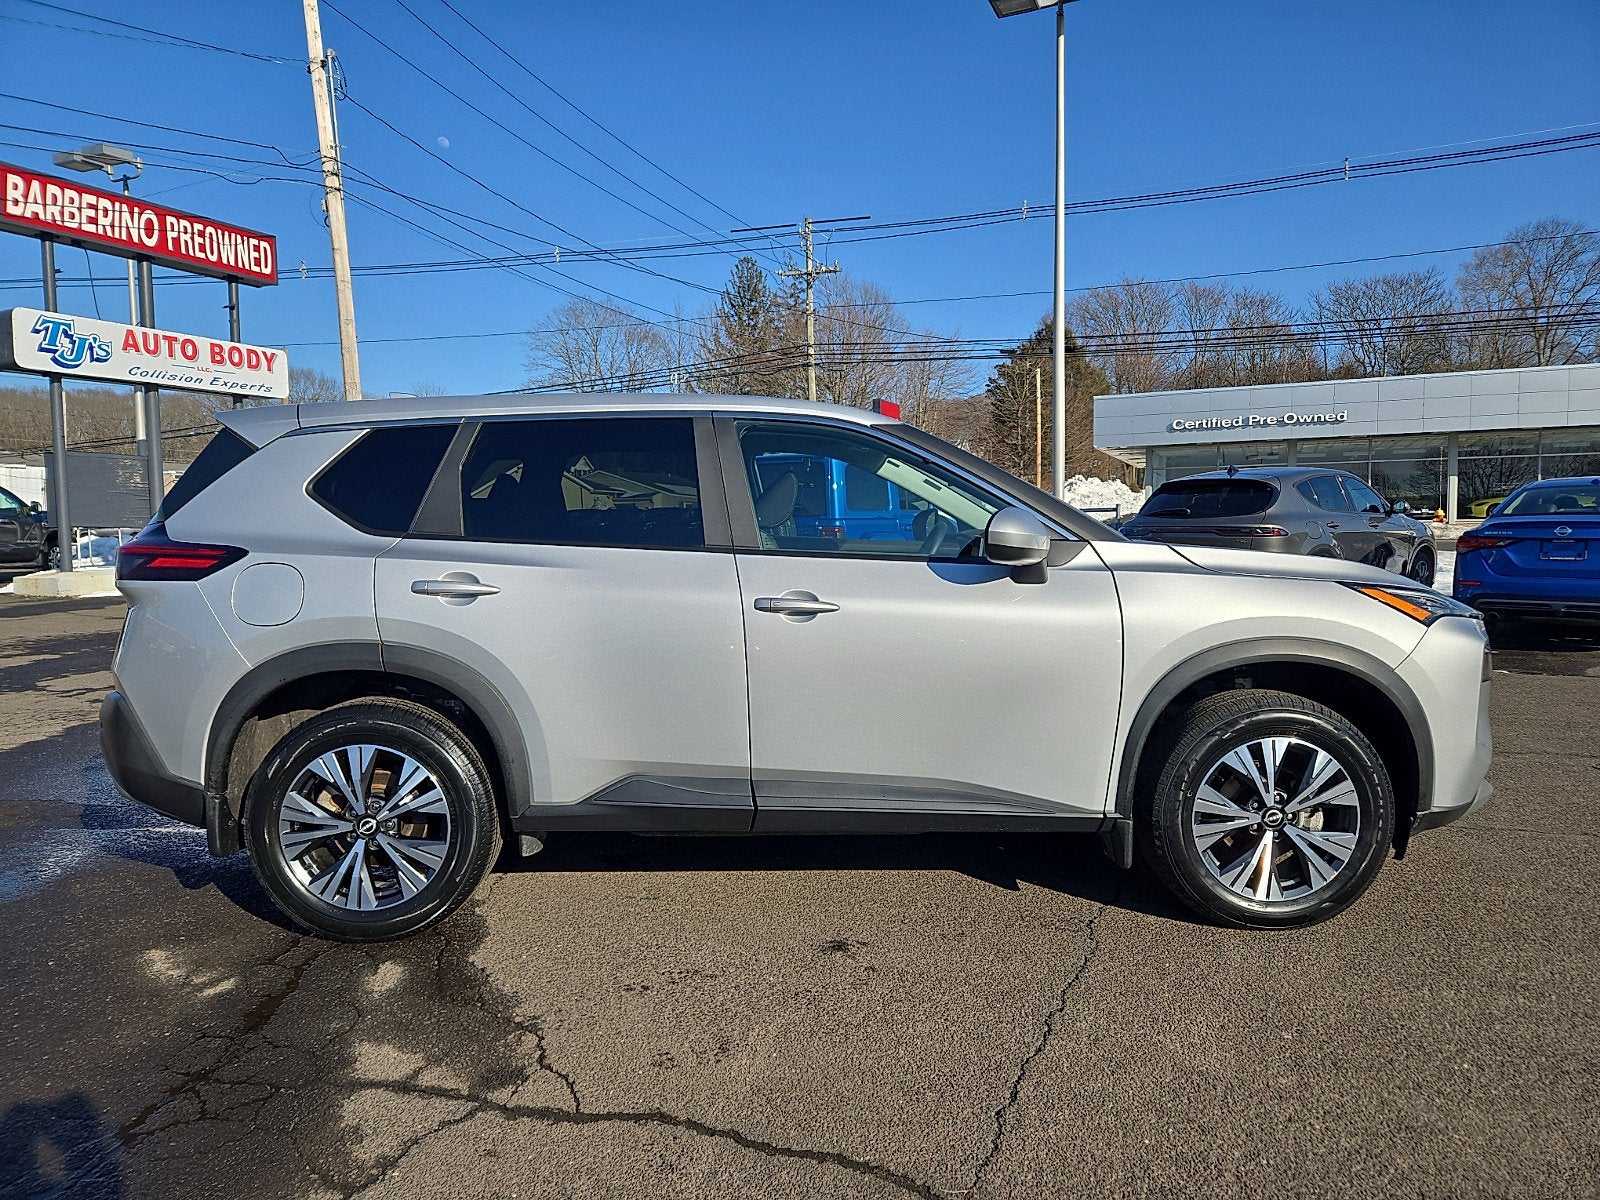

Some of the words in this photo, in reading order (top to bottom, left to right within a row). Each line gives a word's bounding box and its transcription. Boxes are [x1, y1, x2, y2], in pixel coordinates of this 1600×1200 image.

[6, 173, 159, 248] BARBERINO
[165, 215, 272, 275] PREOWNED
[30, 314, 113, 369] TJ's
[122, 329, 199, 361] AUTO
[209, 342, 278, 373] BODY
[128, 366, 204, 385] Collision
[209, 376, 274, 393] Experts
[1172, 415, 1243, 430] Certified
[1249, 410, 1348, 425] Pre-Owned
